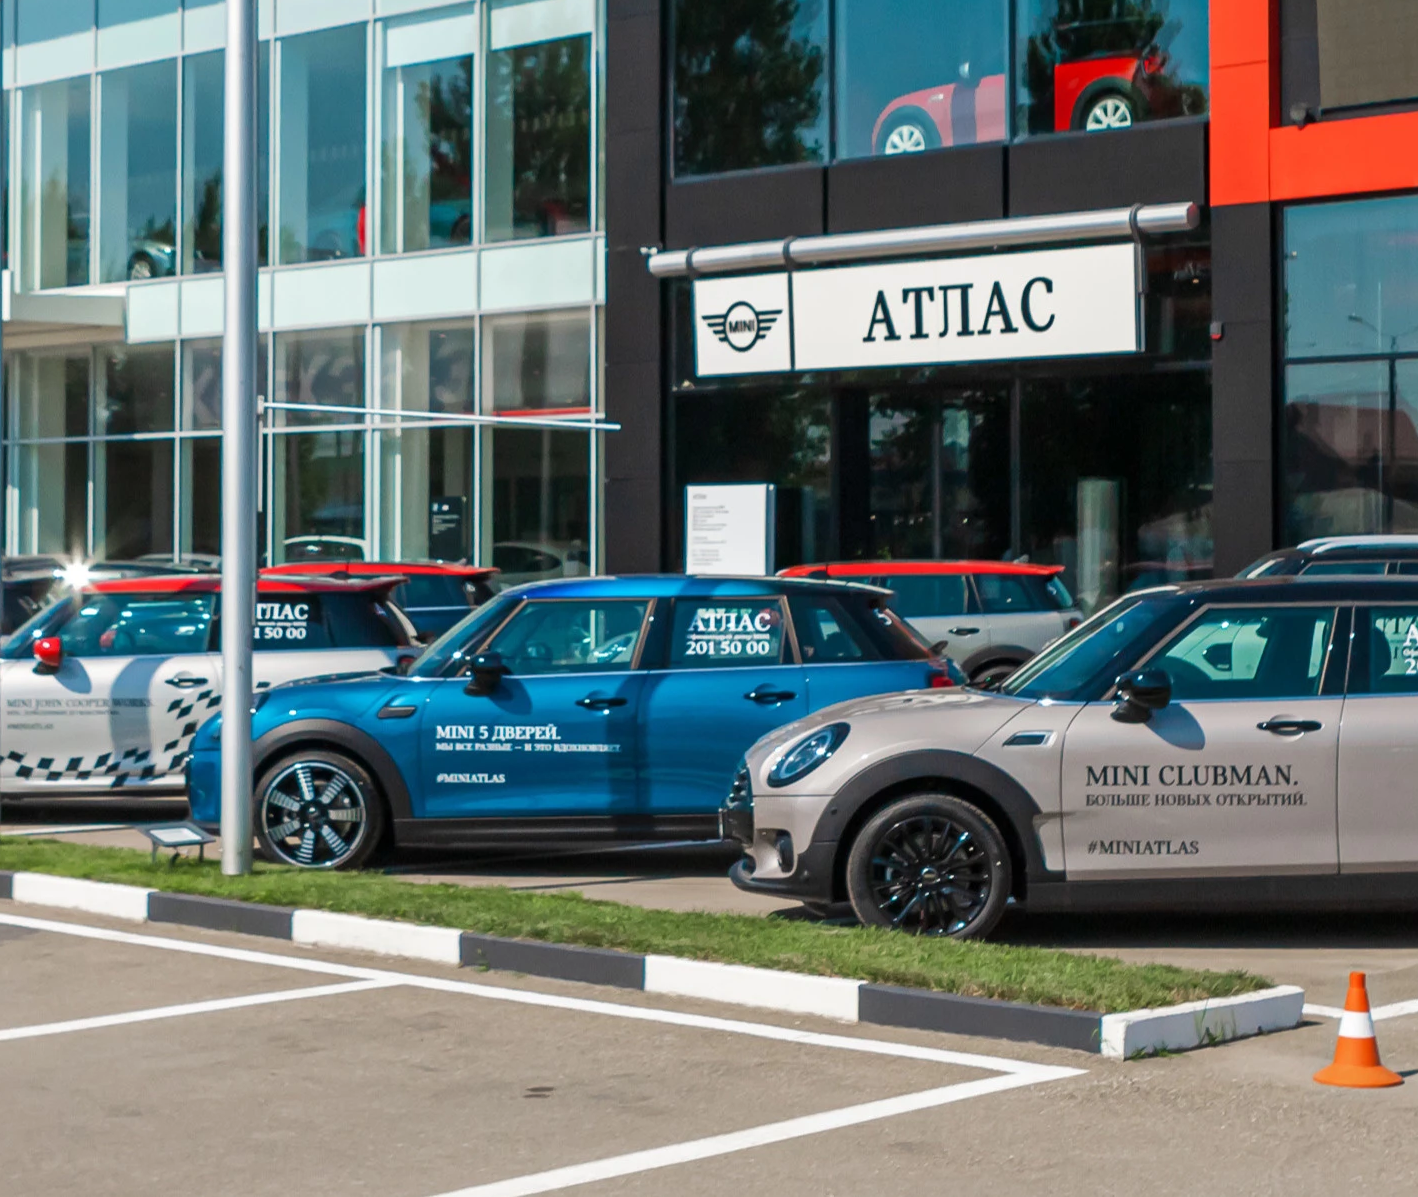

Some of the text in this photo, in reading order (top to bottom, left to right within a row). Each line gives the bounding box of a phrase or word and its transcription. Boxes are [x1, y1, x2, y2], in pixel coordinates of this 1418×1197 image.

[862, 276, 1056, 343] АТЛАС
[728, 319, 756, 333] MINI
[255, 603, 309, 620] ТЛАС
[687, 612, 771, 632] АТЛАС
[264, 627, 283, 639] 50
[285, 627, 307, 640] 00
[685, 641, 770, 655] 201 50 00
[7, 699, 32, 707] MINI
[66, 699, 110, 707] COOPER
[436, 724, 561, 741] MINI 5 ДВЕРЕЙ.
[436, 773, 506, 783] #MINIATLAS
[1086, 765, 1299, 786] MINI CLUBMAN.
[1086, 794, 1150, 806] БОЛЬШЕ
[1154, 794, 1212, 806] НОВЫХ
[1088, 840, 1199, 855] #MINIATLAS
